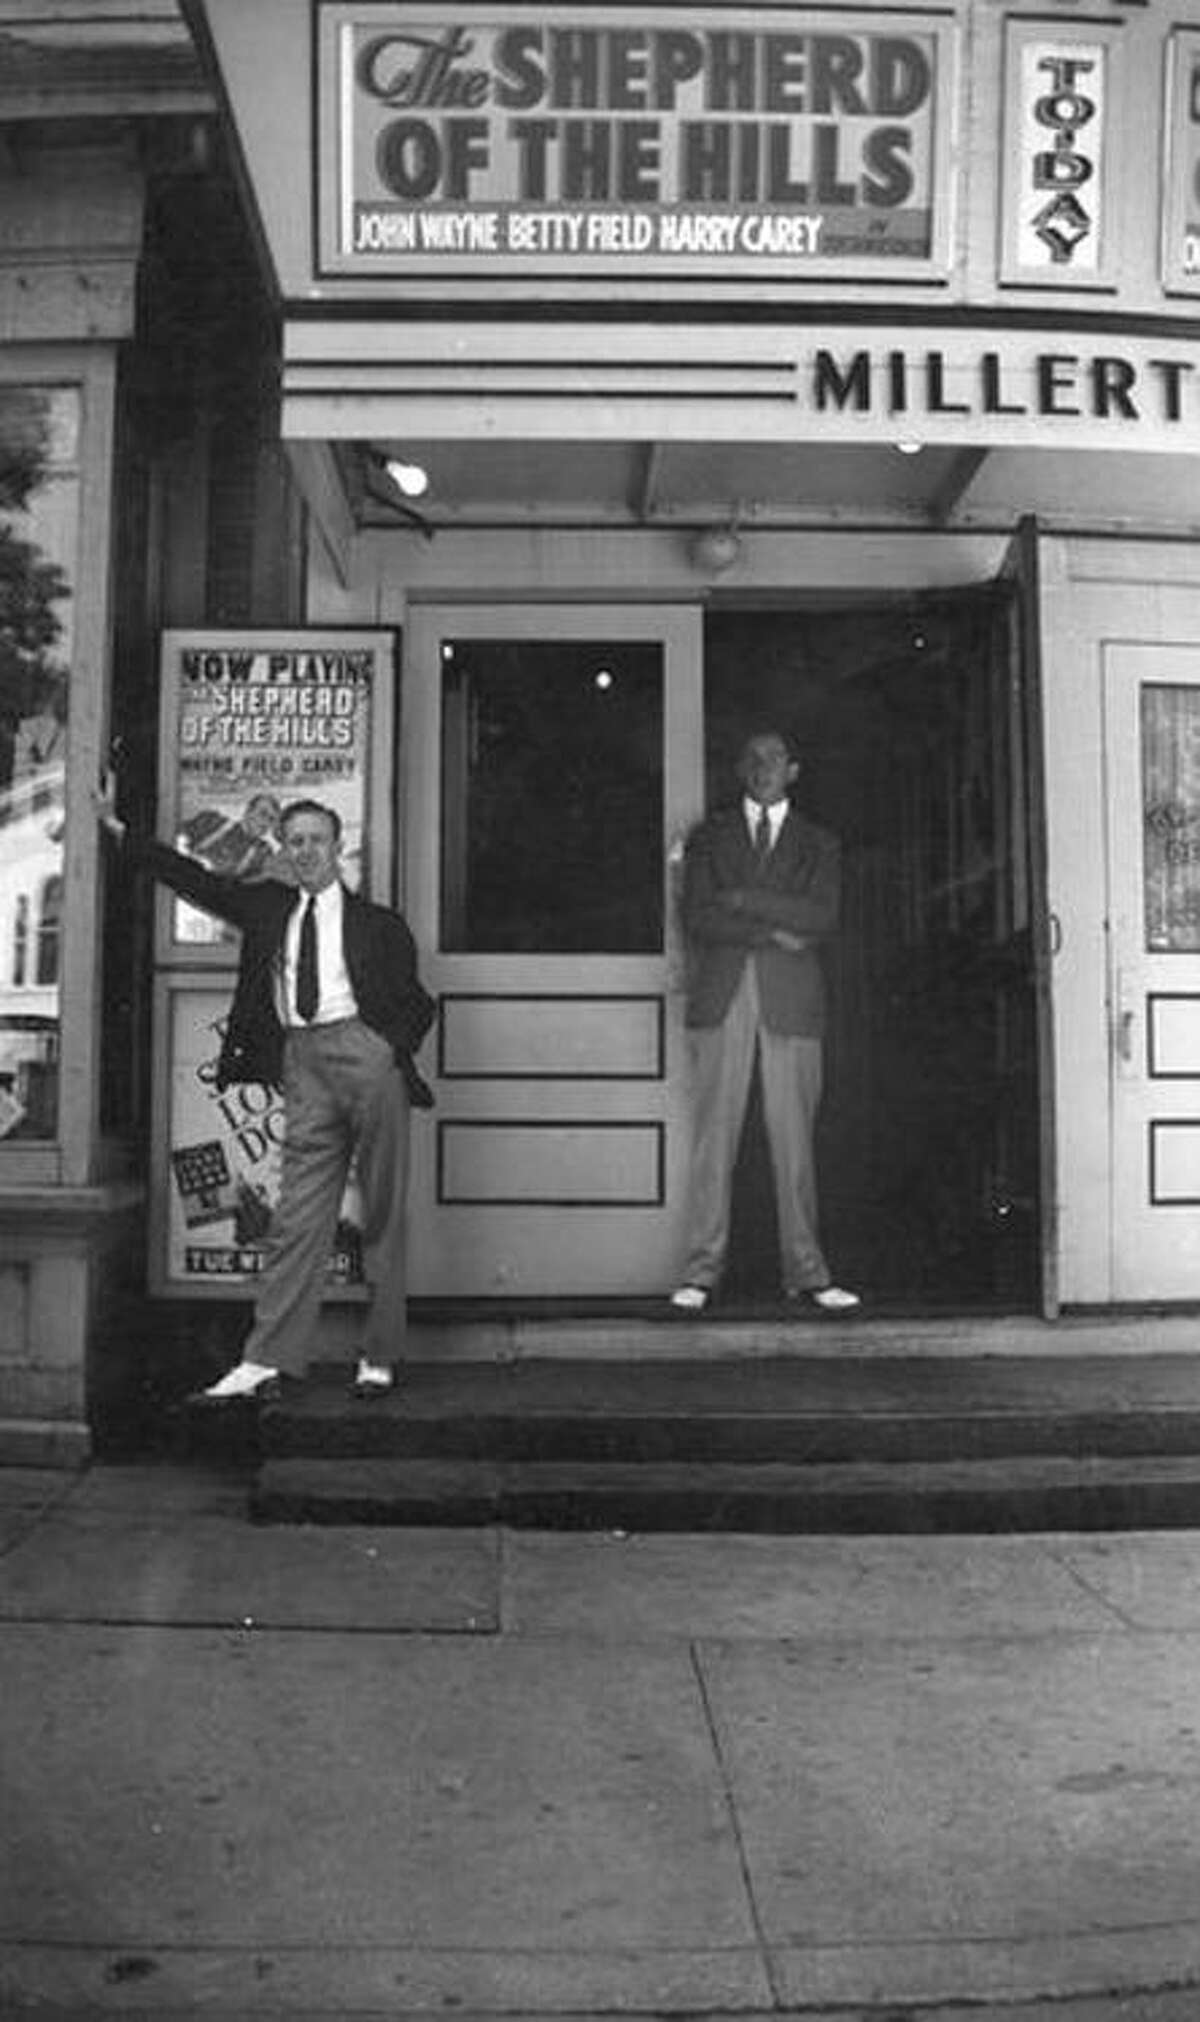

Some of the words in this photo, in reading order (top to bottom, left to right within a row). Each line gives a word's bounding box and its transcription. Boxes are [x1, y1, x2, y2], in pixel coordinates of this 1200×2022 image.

[356, 26, 492, 110] The
[493, 27, 931, 117] SHEPHERD
[376, 117, 491, 201] OF
[508, 119, 661, 203] THE
[679, 121, 915, 208] HILLS
[357, 213, 415, 249] JOHN
[419, 213, 498, 250] WAYNE
[508, 214, 584, 250] BETTY
[587, 214, 651, 250] FIELD
[660, 214, 740, 251] HARRY
[741, 215, 823, 252] CAREY
[182, 652, 253, 682] NOW
[212, 686, 353, 715] SHEPHERD
[182, 717, 215, 743] OF
[220, 717, 270, 743] THE
[272, 717, 353, 744] HILLS
